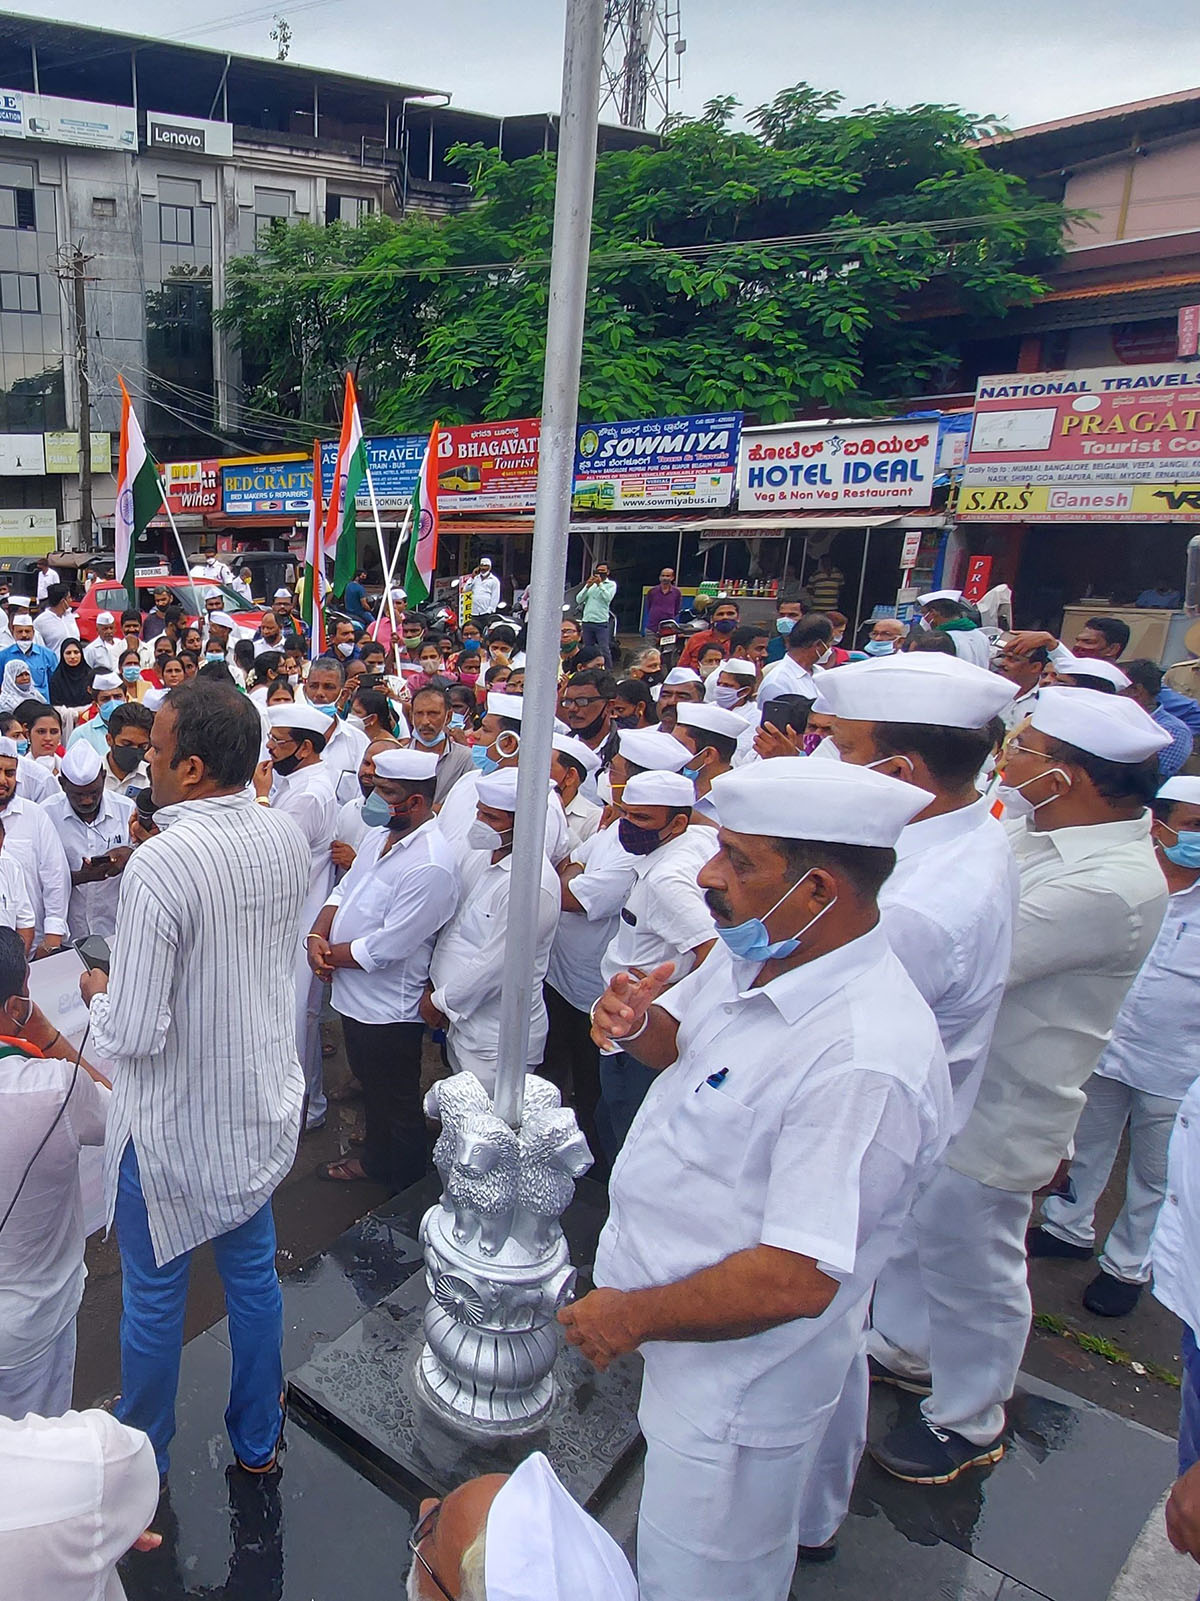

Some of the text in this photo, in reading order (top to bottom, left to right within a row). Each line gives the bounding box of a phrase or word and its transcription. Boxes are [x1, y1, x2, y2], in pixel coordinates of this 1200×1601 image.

[155, 128, 201, 147] Lenovo
[979, 381, 1092, 399] NATIONAL
[600, 431, 729, 458] SOWMIYA
[748, 440, 824, 462] ಹೋಟೆಲ್
[1081, 438, 1162, 455] Tourist
[494, 456, 535, 470] Tourist
[748, 458, 924, 489] HOTEL IDEAL
[181, 492, 216, 508] Wines
[230, 493, 242, 501] BED
[244, 491, 269, 500] MAKERS
[275, 490, 309, 499] REPAIRERS
[623, 496, 717, 507] www.sowmiyabus.in
[754, 487, 913, 502] Veg & Non Veg Restaurant
[1051, 491, 1128, 508] Ganesh
